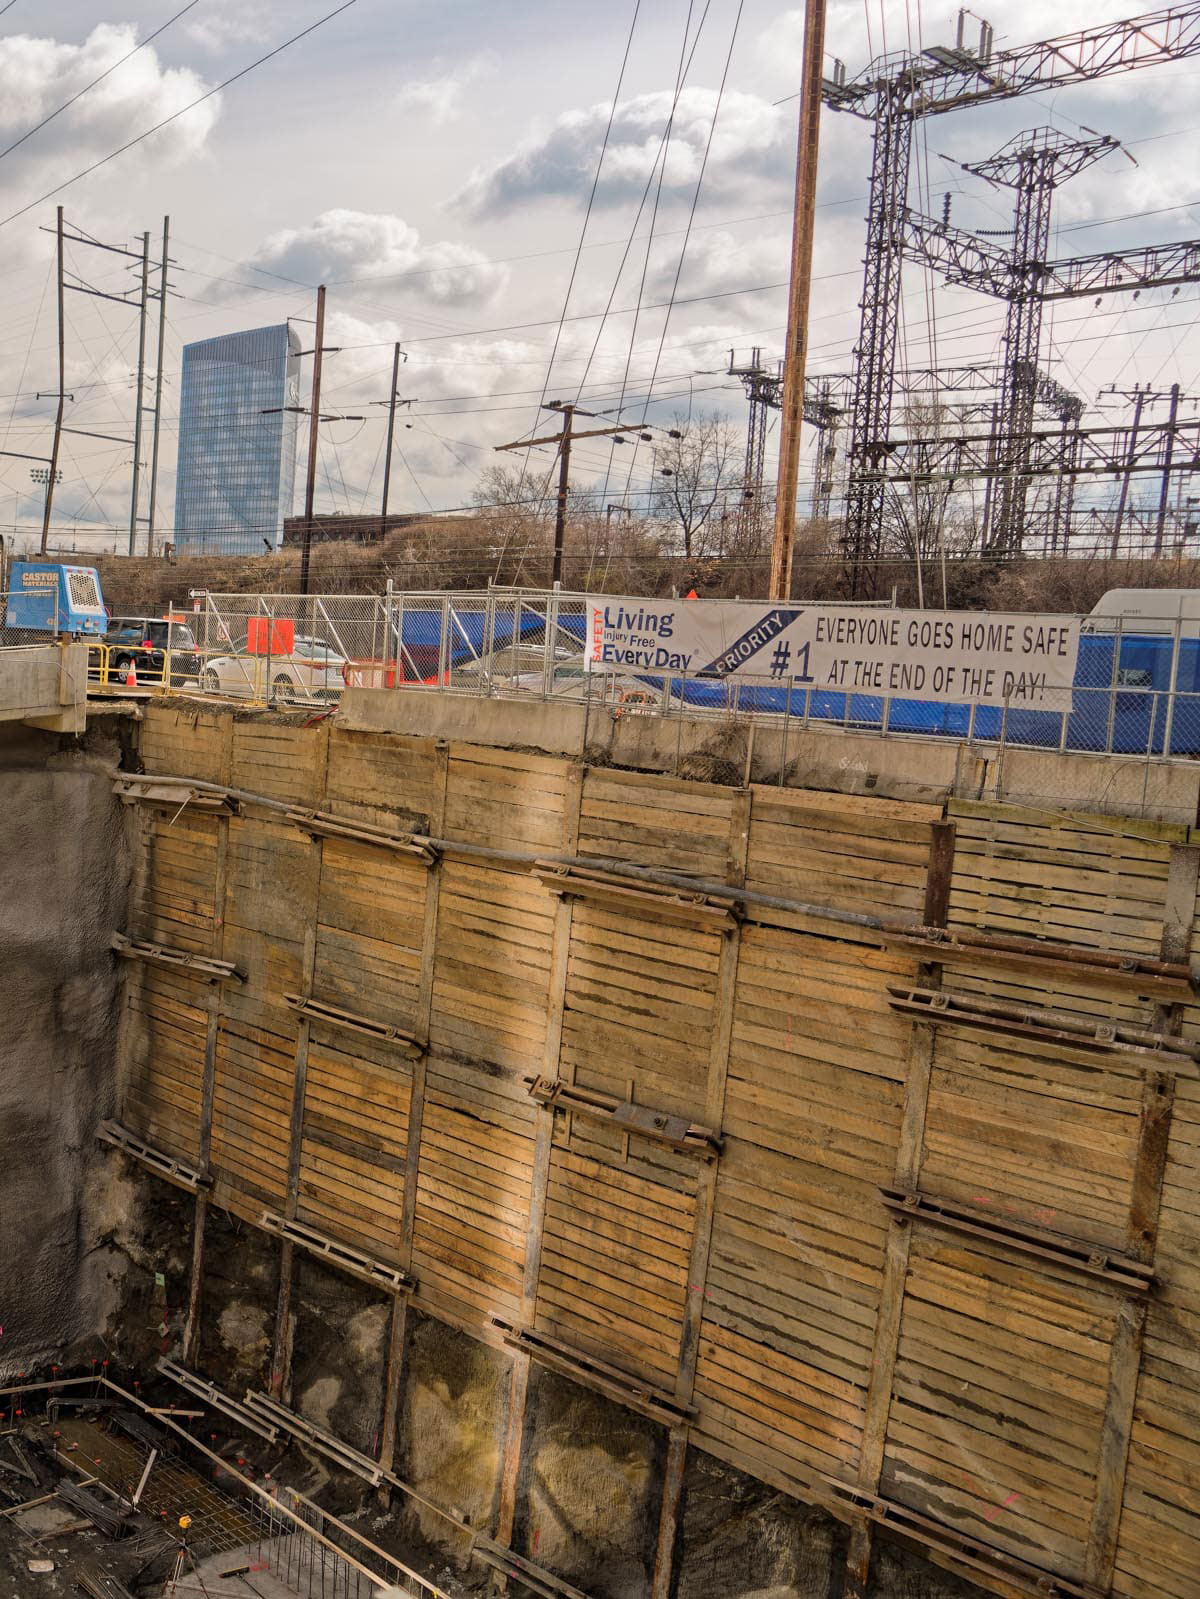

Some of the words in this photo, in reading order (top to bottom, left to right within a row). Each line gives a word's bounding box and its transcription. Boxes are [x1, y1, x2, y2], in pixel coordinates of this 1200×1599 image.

[22, 572, 59, 581] CASTOR
[592, 606, 604, 663] SAFETY
[603, 631, 628, 644] Injury
[629, 634, 656, 648] Free
[604, 606, 675, 638] Living
[715, 612, 784, 673] PRIORITY
[816, 616, 901, 647] EVERYONE
[908, 620, 954, 649] GOES
[961, 623, 1014, 653] HOME
[1021, 625, 1070, 657] SAFE
[769, 640, 815, 682] #1
[827, 659, 849, 685] AT
[854, 660, 884, 687] THE
[889, 663, 926, 691] END
[933, 666, 956, 693] OF
[962, 667, 997, 697] THE
[1003, 670, 1047, 701] DAY!
